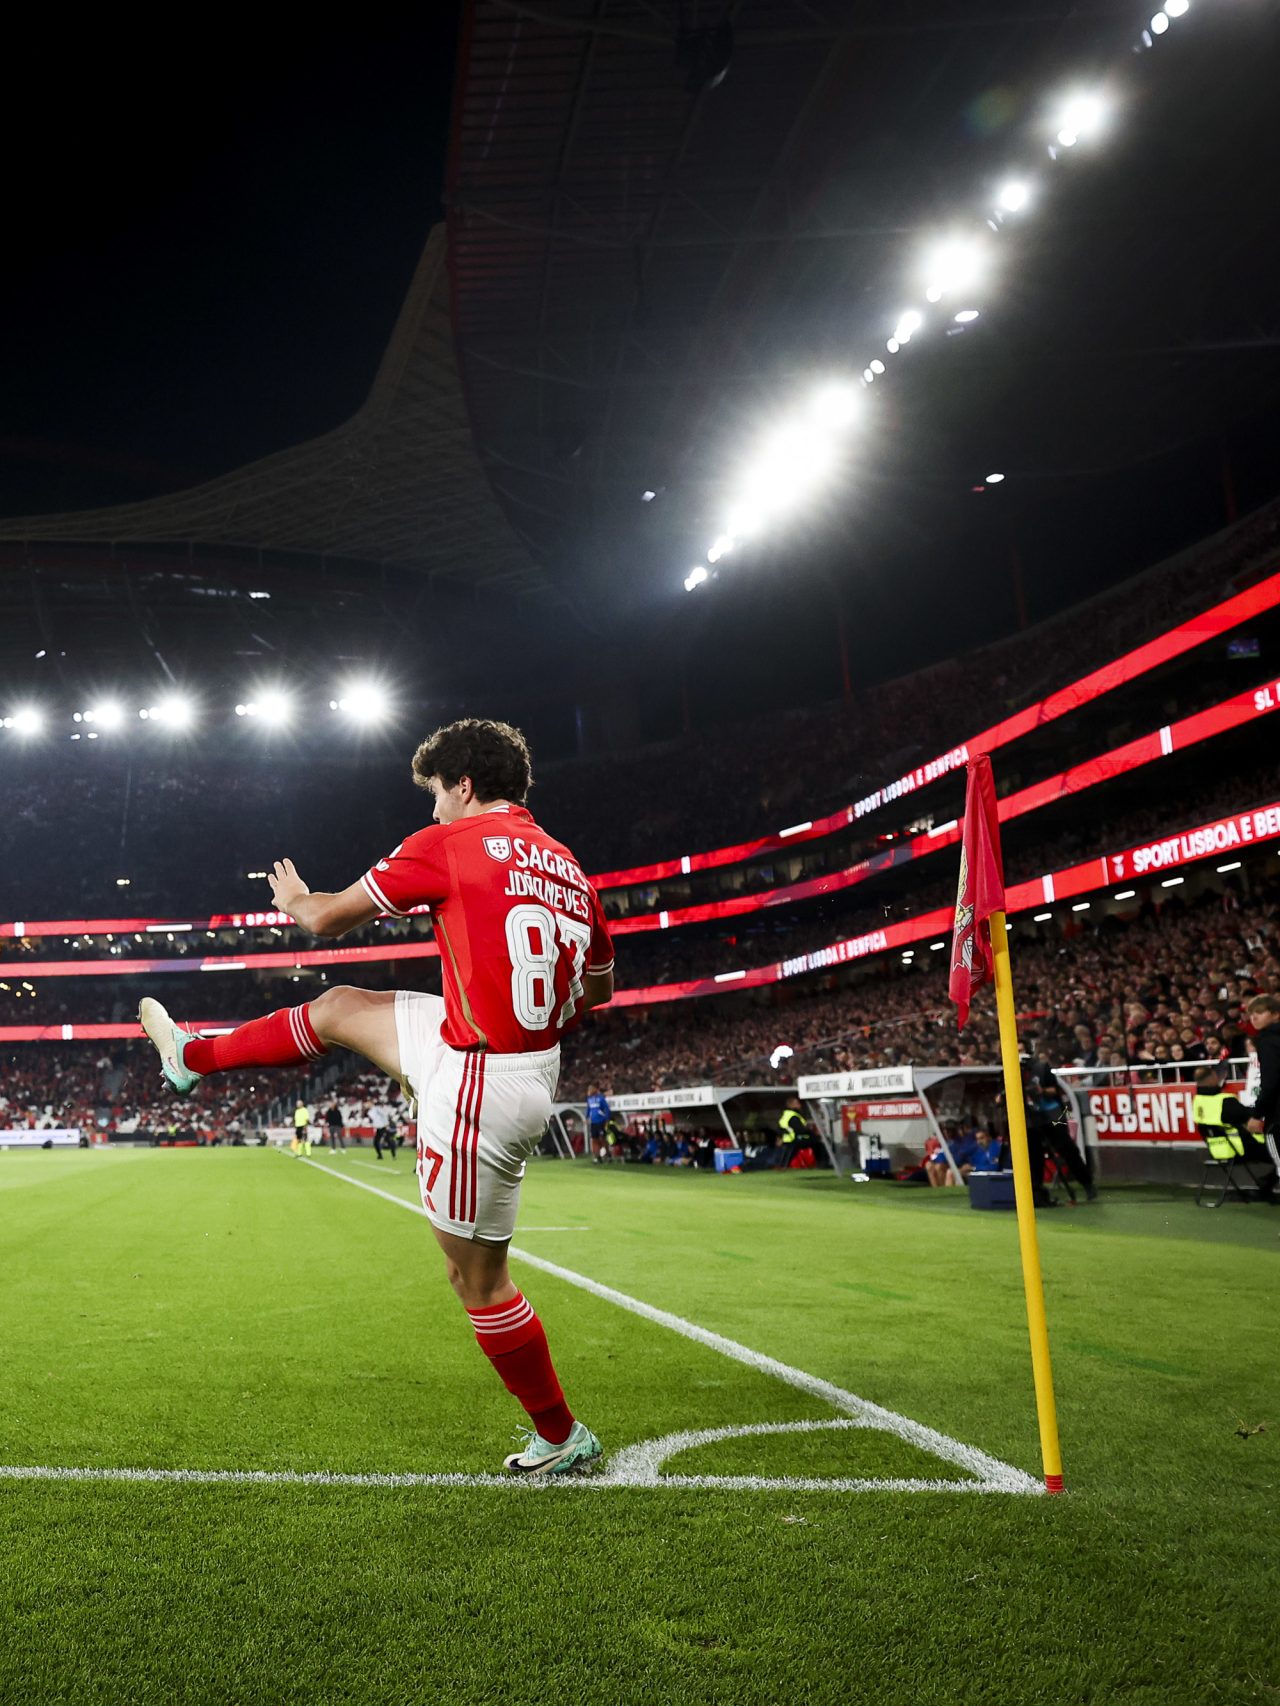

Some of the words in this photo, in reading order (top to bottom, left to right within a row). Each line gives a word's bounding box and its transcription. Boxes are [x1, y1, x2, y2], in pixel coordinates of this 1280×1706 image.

[1254, 688, 1275, 711] SL
[854, 791, 881, 818] SPORT
[881, 774, 916, 804] LISBOA
[916, 768, 924, 786] E
[924, 745, 970, 781] BENFICA
[513, 838, 589, 893] SAGRES
[1133, 837, 1181, 873] SPORT
[1180, 820, 1241, 859] LISBOA
[1240, 816, 1254, 842] E
[505, 904, 591, 1030] 87
[783, 955, 808, 977] SPORT
[807, 945, 839, 970] LISBOA
[838, 943, 847, 961] E
[846, 930, 888, 959] BENFICA
[1089, 1091, 1197, 1134] SLBENFI
